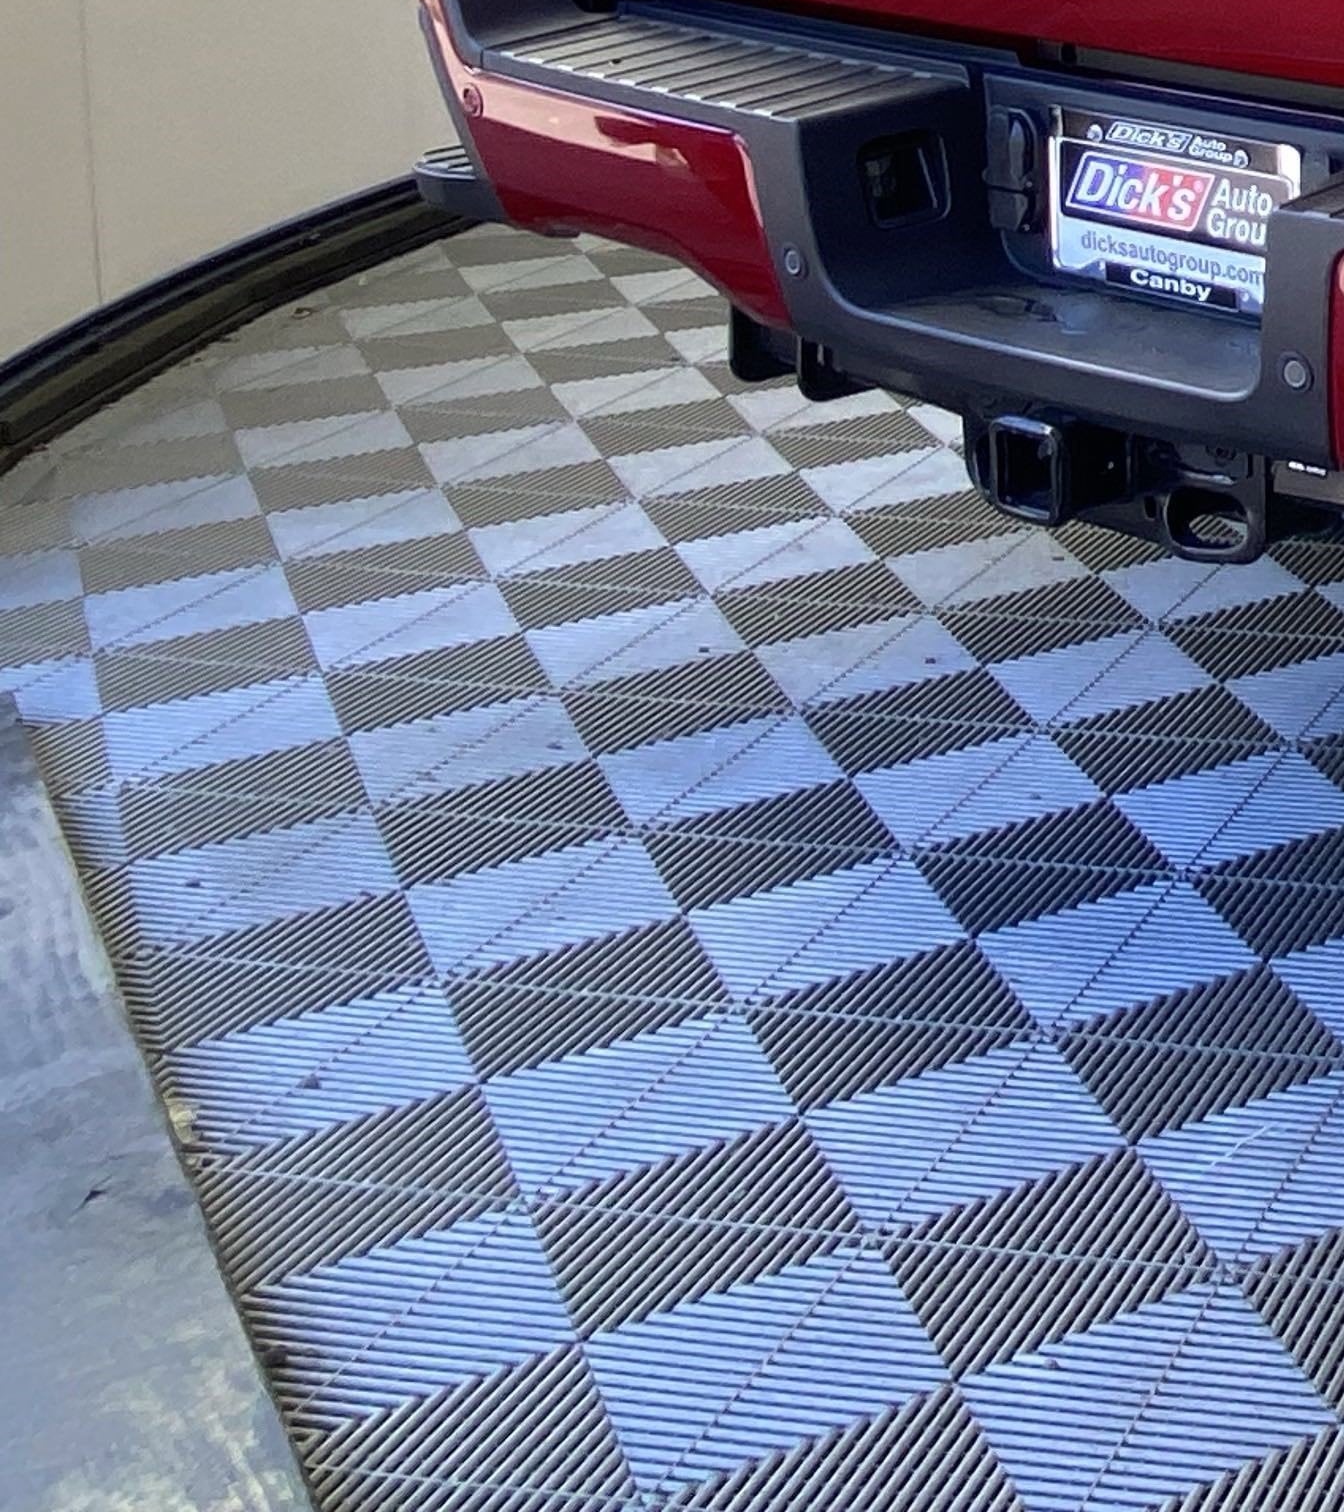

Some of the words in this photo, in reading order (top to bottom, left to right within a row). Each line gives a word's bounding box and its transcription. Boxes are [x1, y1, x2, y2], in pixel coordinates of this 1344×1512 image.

[1111, 123, 1184, 150] Dick's
[1194, 136, 1227, 152] Auto
[1188, 143, 1233, 163] Group
[1073, 160, 1198, 222] Dick's
[1211, 178, 1274, 218] Auto
[1205, 208, 1266, 246] Grou
[1080, 229, 1263, 285] dicksautogroup.com
[1129, 268, 1212, 302] Canby
